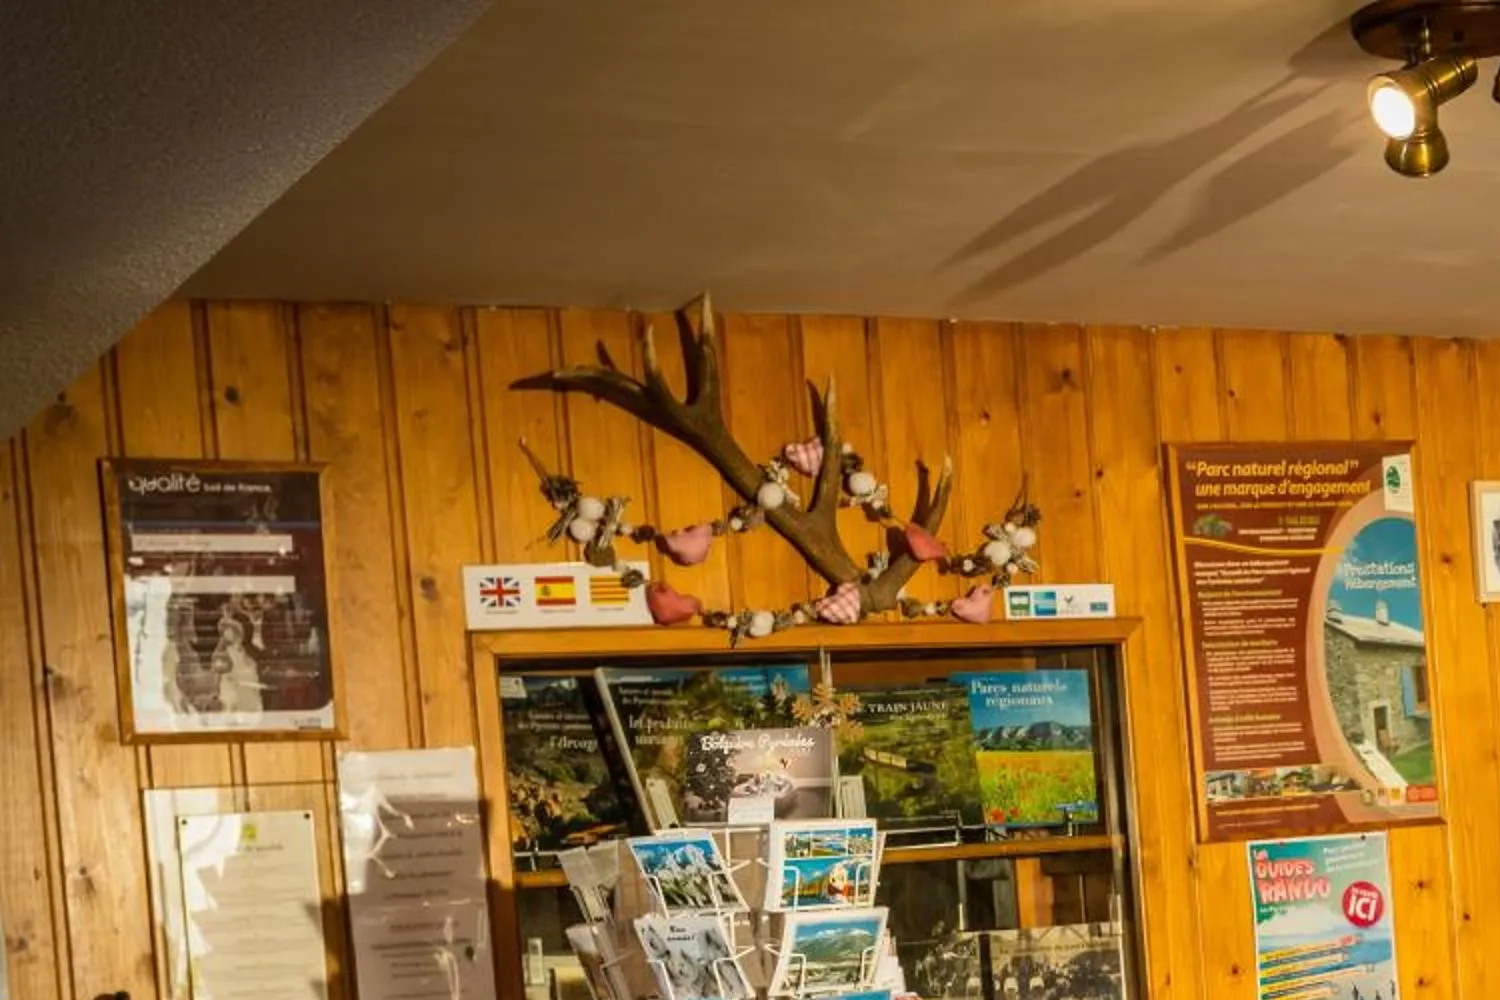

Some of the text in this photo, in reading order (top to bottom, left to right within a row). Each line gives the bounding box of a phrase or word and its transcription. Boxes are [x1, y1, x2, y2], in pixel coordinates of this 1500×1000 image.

[1232, 459, 1286, 477] naturel
[128, 473, 200, 496] qualité
[1196, 478, 1371, 499] une marque d'engagement
[971, 678, 1067, 695] Parcs naturels
[867, 703, 907, 714] TRAIN
[1258, 877, 1331, 904] RANDO
